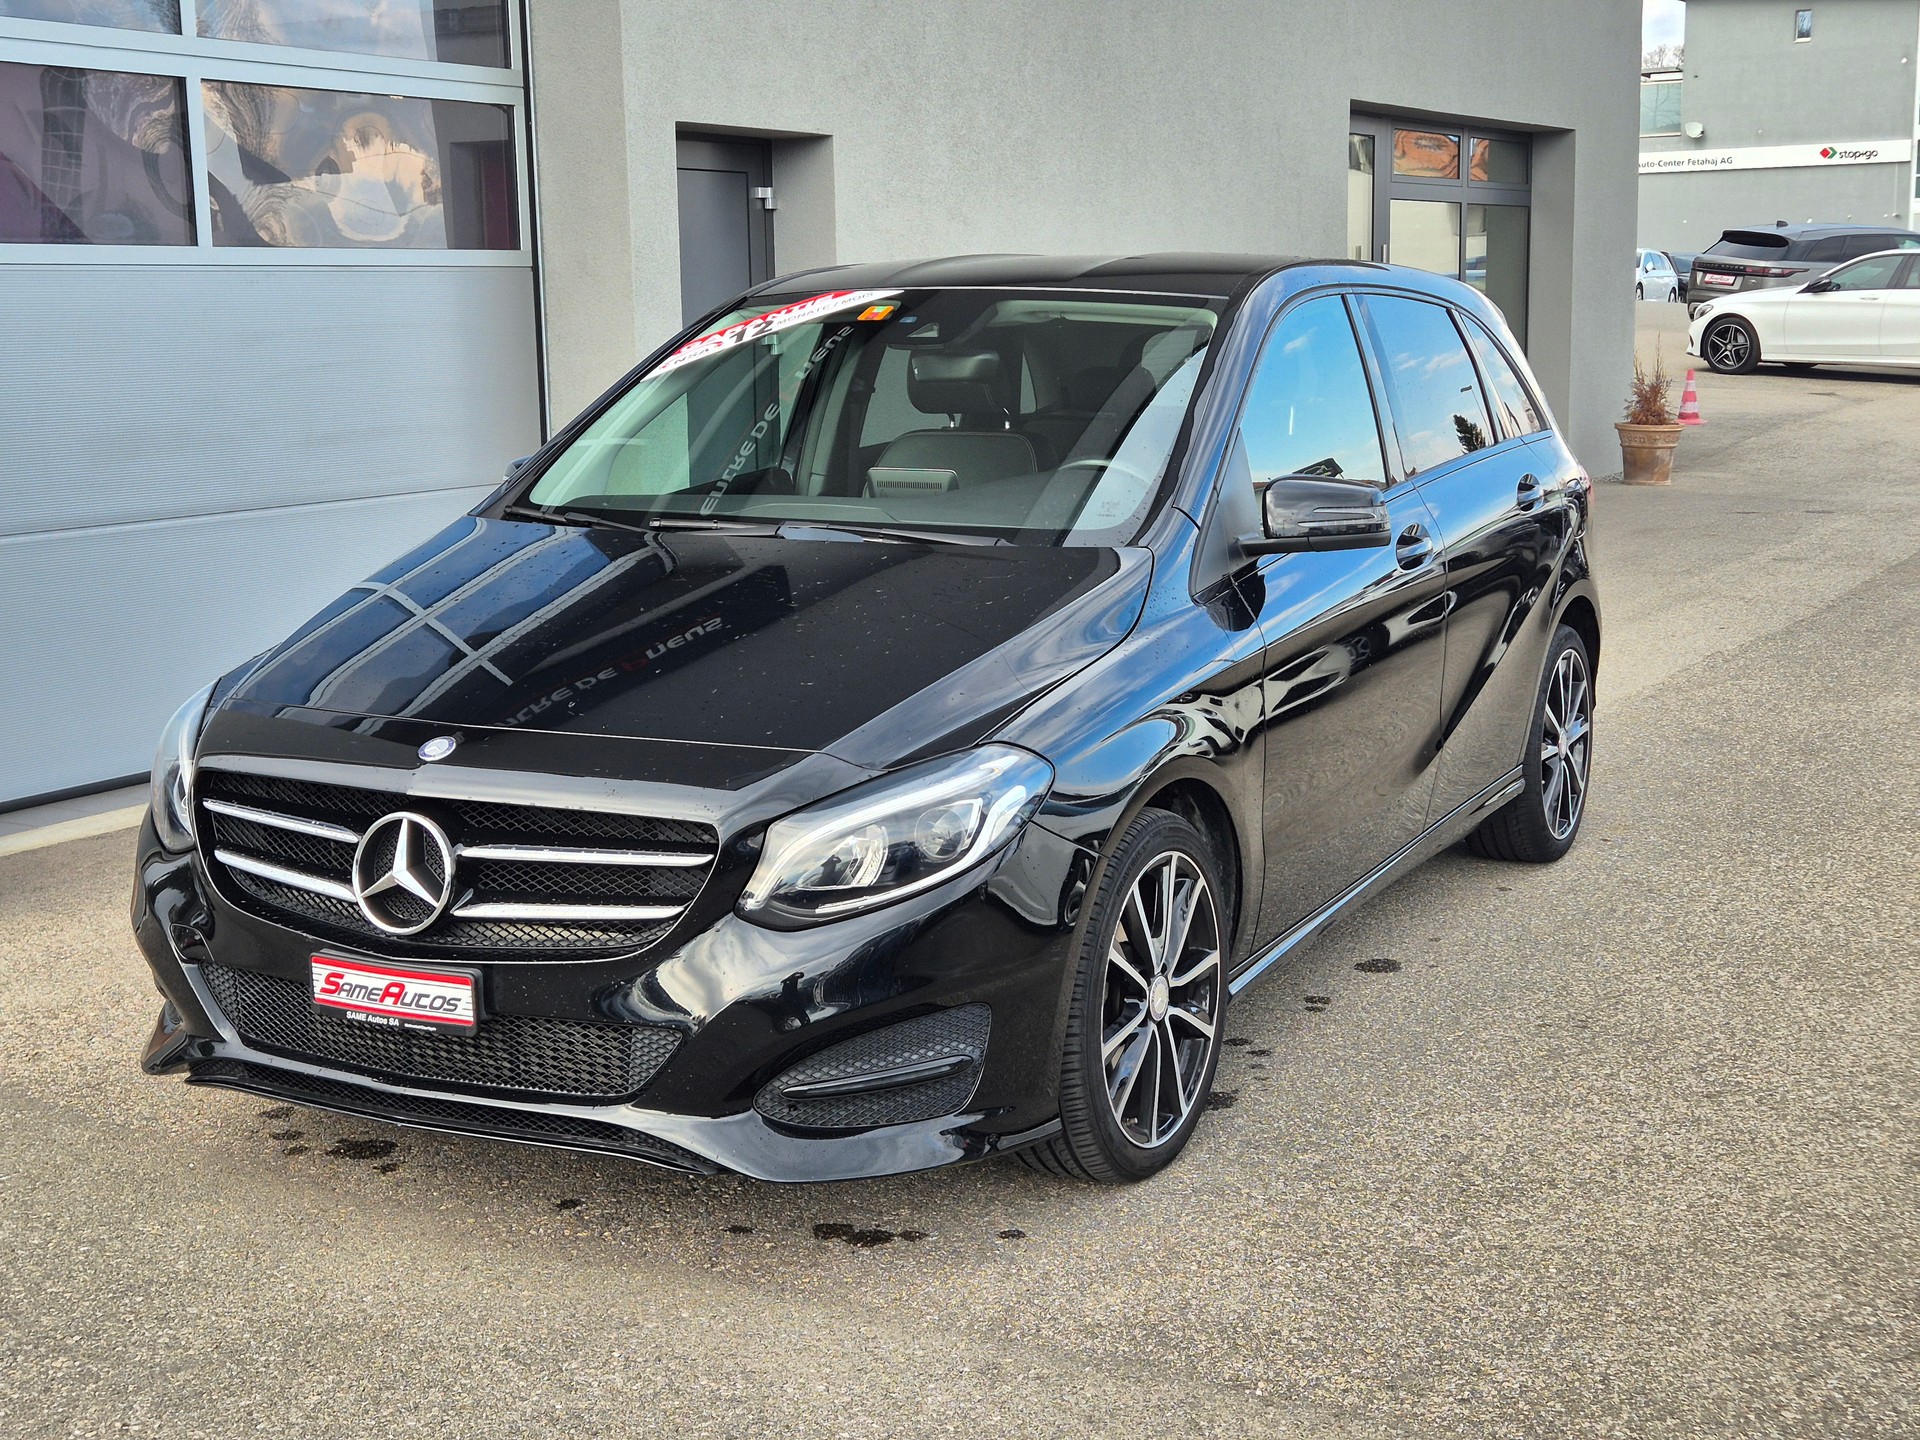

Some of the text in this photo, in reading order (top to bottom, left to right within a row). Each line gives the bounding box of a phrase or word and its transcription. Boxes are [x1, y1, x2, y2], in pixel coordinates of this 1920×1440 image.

[1687, 157, 1718, 167] Fetahaj
[1720, 156, 1733, 165] AG
[729, 319, 775, 344] 12
[776, 303, 832, 325] MONATE
[841, 292, 875, 304] MOIS
[346, 1010, 367, 1022] SAME
[367, 1014, 388, 1025] Autos
[388, 1016, 400, 1027] SA
